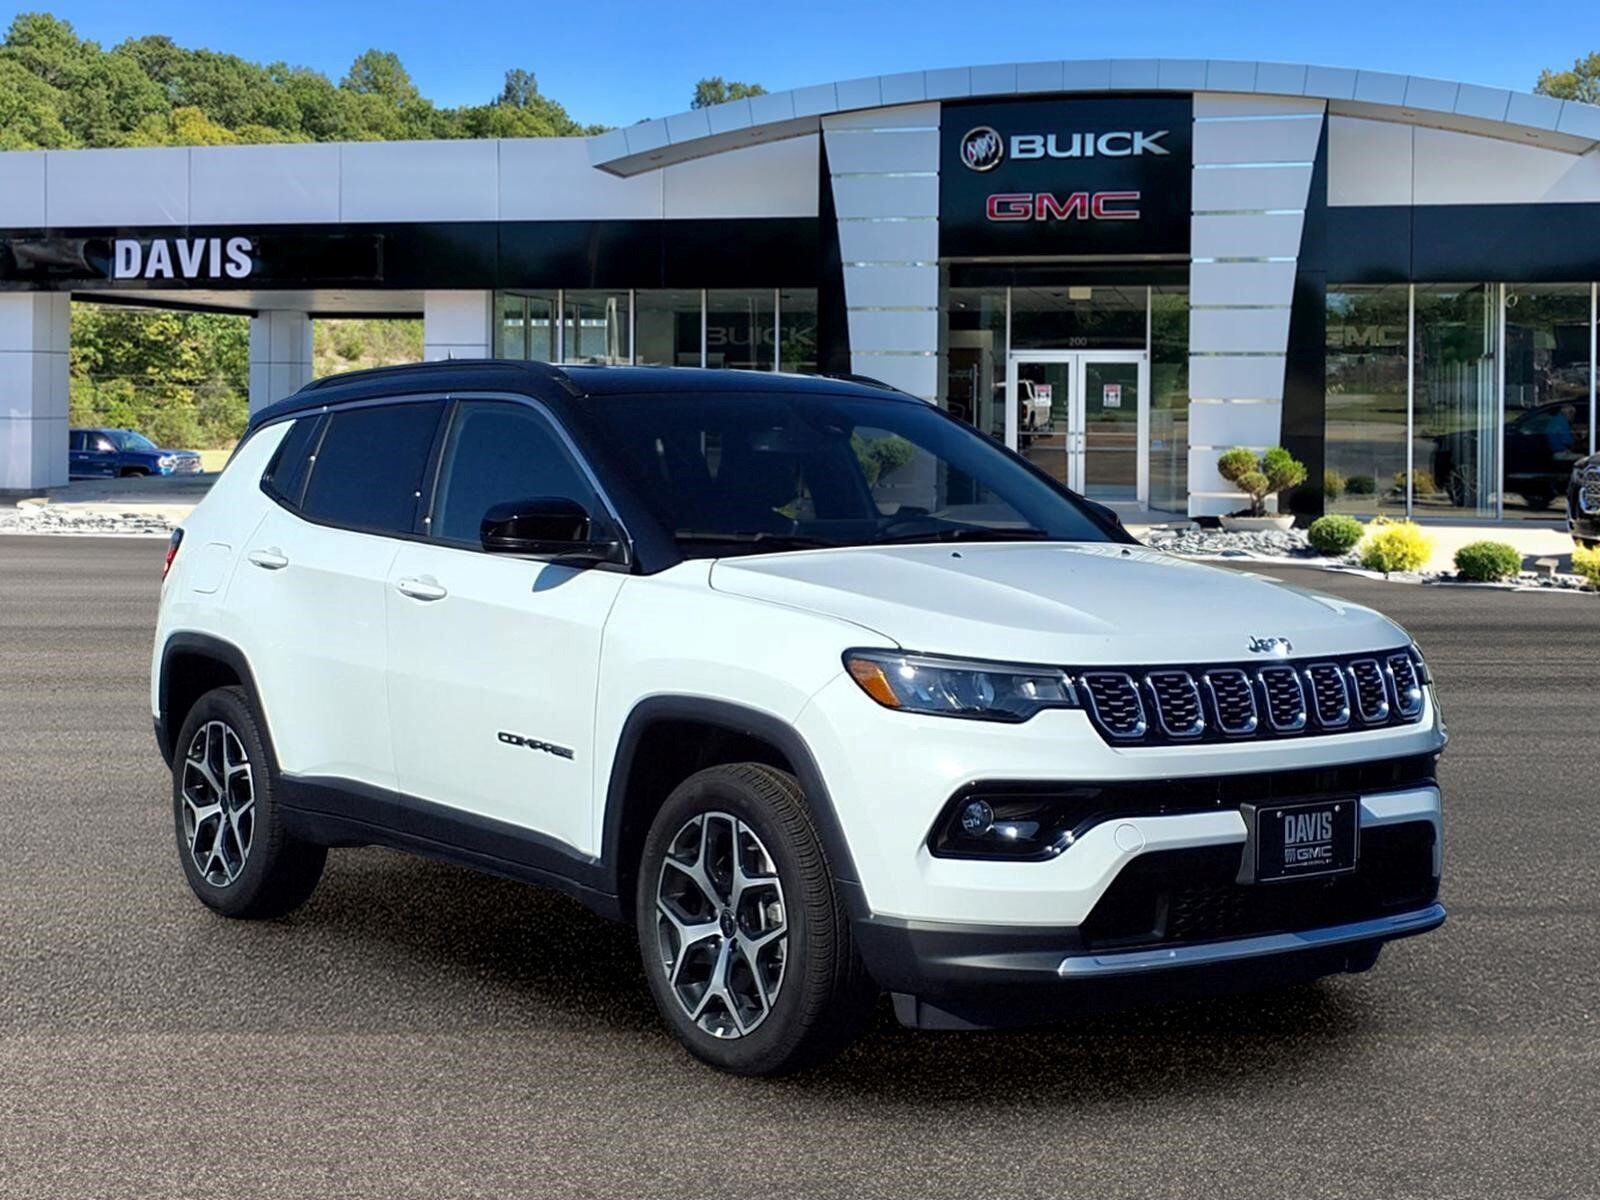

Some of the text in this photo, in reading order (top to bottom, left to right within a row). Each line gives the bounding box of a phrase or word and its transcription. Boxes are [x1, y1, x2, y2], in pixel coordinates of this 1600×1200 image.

[1009, 130, 1170, 160] BUICK
[986, 191, 1141, 221] GMC
[114, 237, 253, 279] DAVIS
[706, 324, 817, 346] BUICK
[1284, 811, 1333, 844] DAVIS
[1296, 845, 1333, 861] GMC
